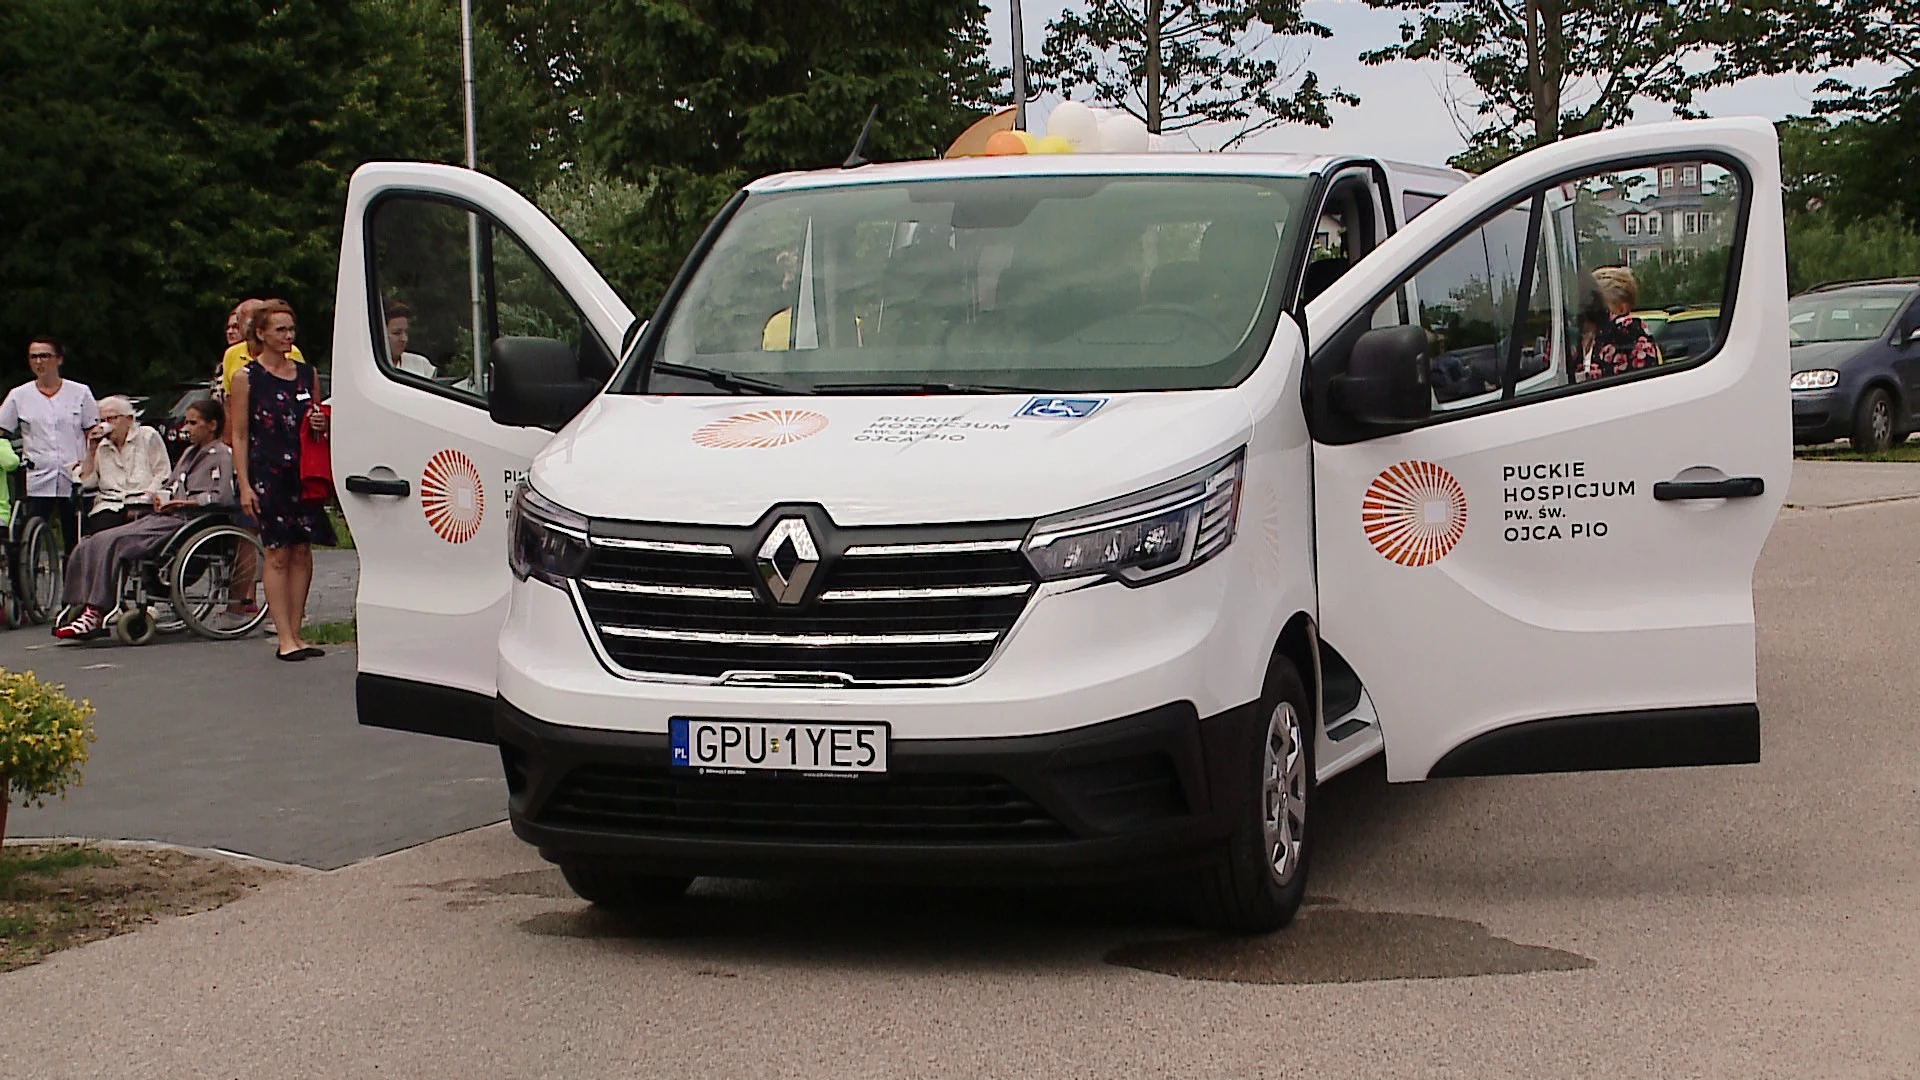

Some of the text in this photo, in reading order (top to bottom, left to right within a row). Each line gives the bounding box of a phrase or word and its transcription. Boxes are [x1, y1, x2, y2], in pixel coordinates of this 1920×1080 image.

[854, 434, 913, 442] OJCA
[1503, 462, 1585, 481] PUCKIE
[1504, 480, 1635, 502] HOSPICJUM
[1504, 504, 1566, 520] PW. ŚW.
[1504, 522, 1608, 542] OJCA PIO
[675, 748, 687, 759] PL
[696, 725, 876, 767] GPU 1YE5
